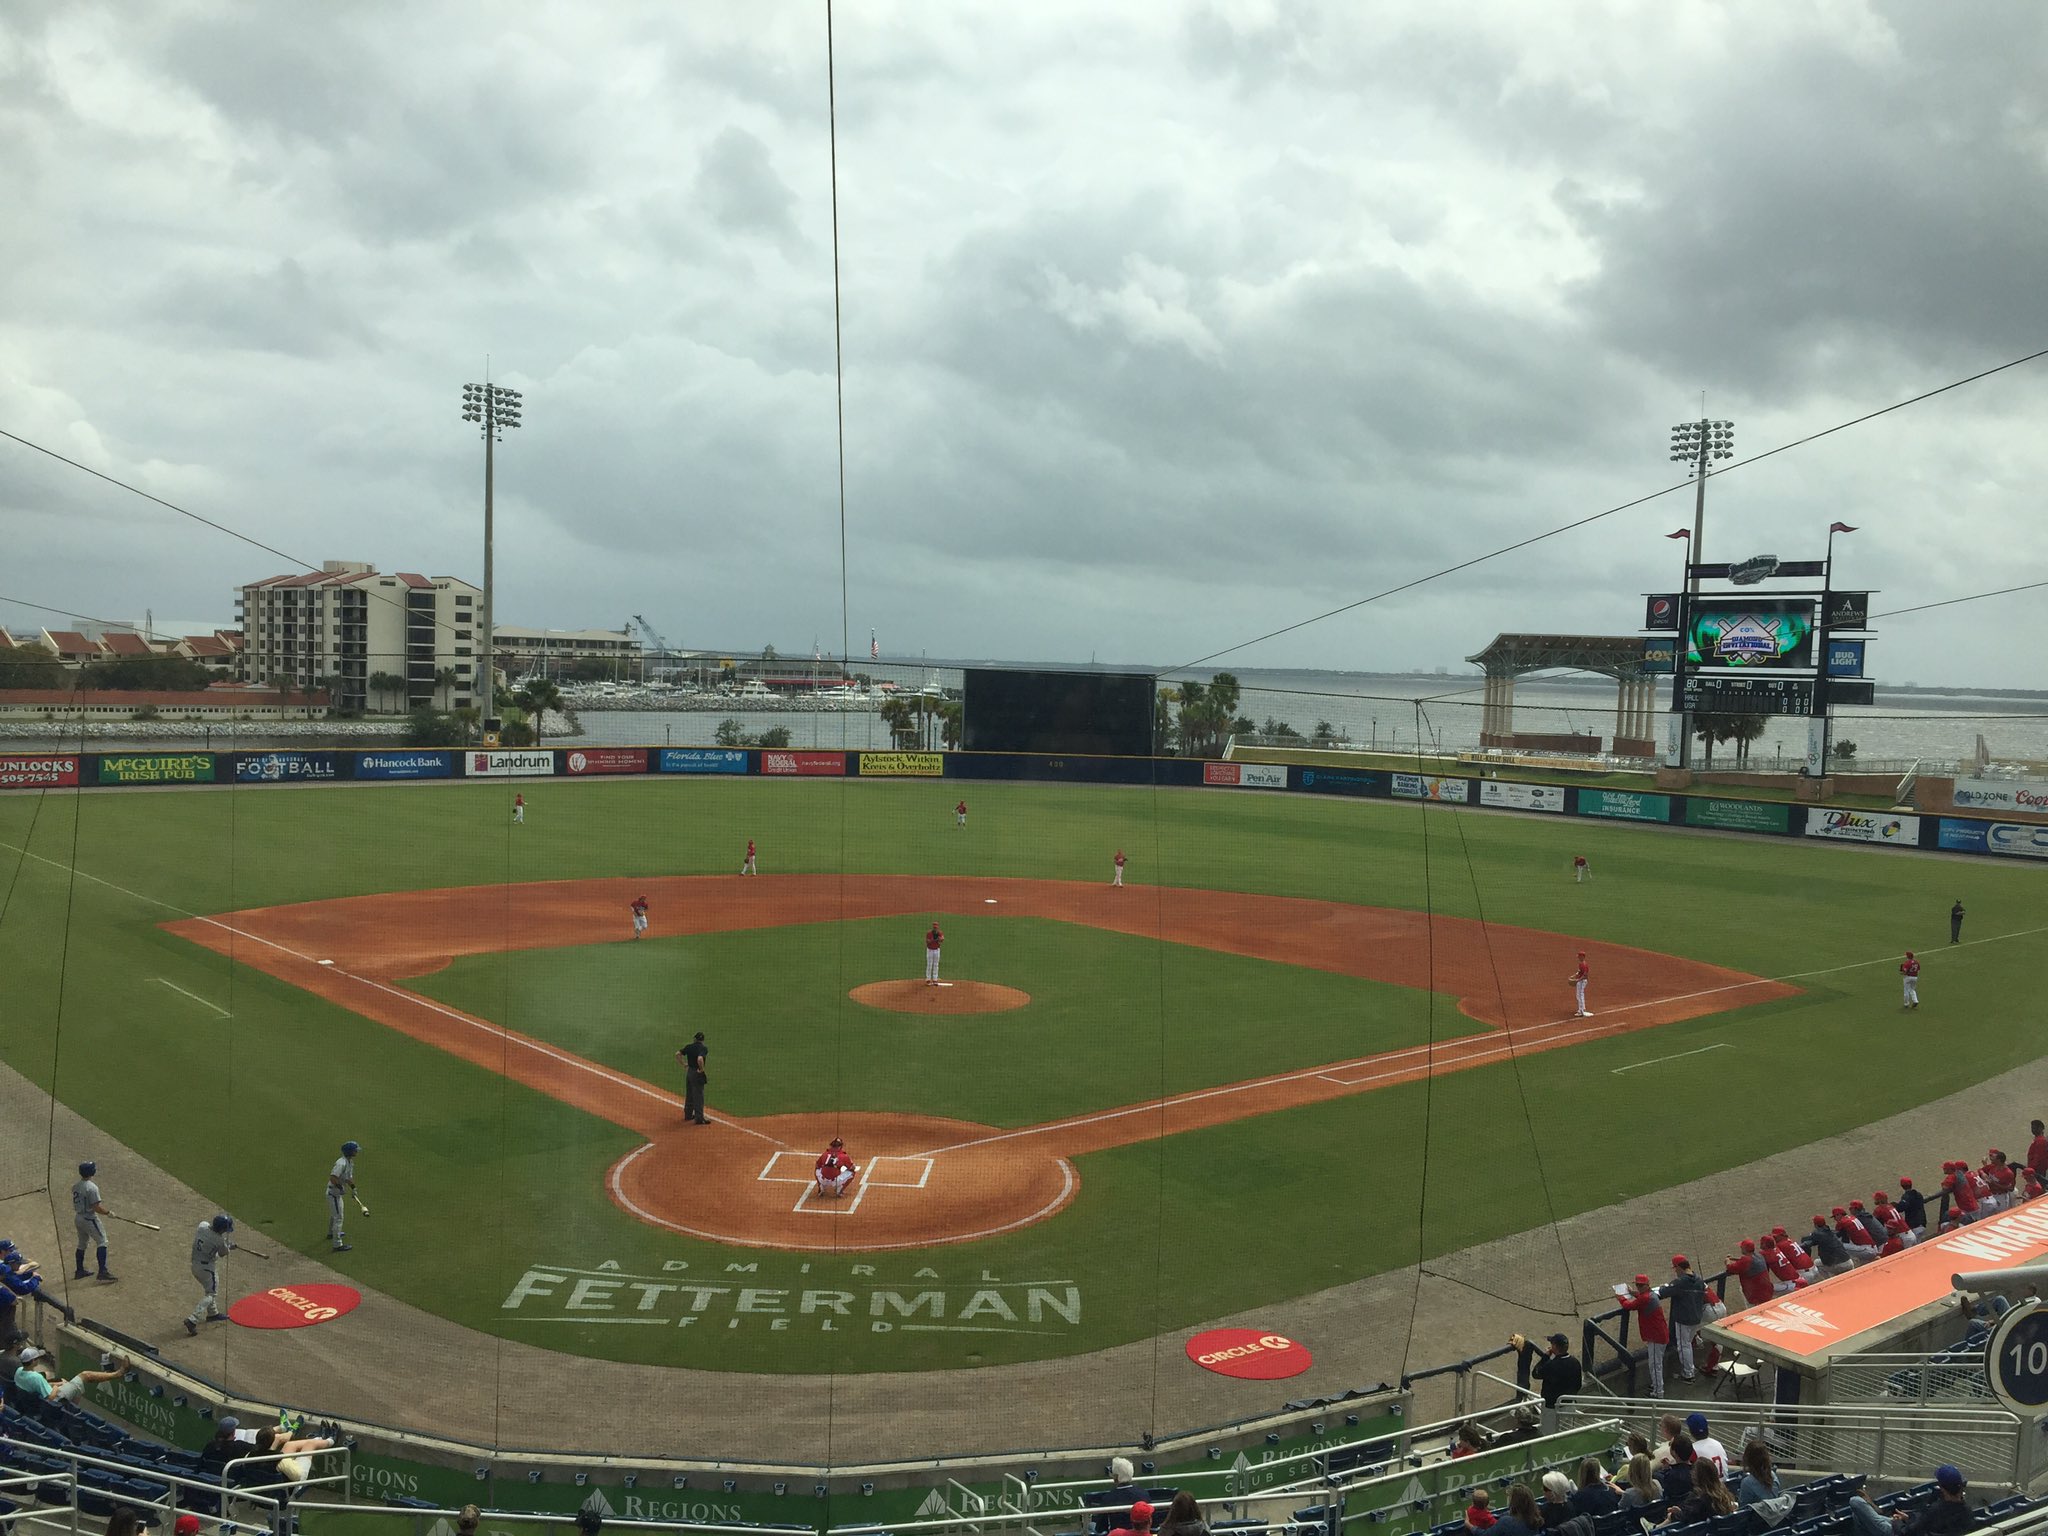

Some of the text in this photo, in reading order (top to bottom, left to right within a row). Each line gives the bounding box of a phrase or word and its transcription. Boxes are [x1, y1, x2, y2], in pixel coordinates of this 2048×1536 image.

[1645, 650, 1672, 661] COX
[1834, 651, 1855, 659] BUD
[1830, 658, 1858, 666] LIGHT
[1686, 679, 1698, 689] 80
[1715, 679, 1722, 689] 0
[1746, 680, 1753, 690] 0
[1777, 681, 1784, 691] 0
[490, 755, 550, 768] Landrum
[666, 752, 723, 760] Florida Blue
[374, 757, 442, 768] Hancock Bank
[897, 762, 941, 771] Overholtz
[236, 762, 335, 775] FOOTBALL
[120, 770, 195, 781] IRISH PUB
[1247, 773, 1282, 783] Pen Air
[1957, 790, 2009, 801] COLD ZONE
[1602, 805, 1641, 814] INSURANCE
[1719, 802, 1764, 812] WOODLANDS
[1823, 811, 1878, 828] Dlux
[595, 1259, 1001, 1282] ADMIRAL
[268, 1287, 318, 1311] CIRCLE
[501, 1271, 1081, 1325] FETTERMAN
[677, 1316, 895, 1333] FIELD
[1198, 1335, 1291, 1364] CIRCLE K
[2009, 1341, 2048, 1376] 10
[118, 1382, 175, 1428] REGIONS
[95, 1393, 175, 1441] CLUB SEATS
[1224, 1472, 1274, 1493] CLUB
[624, 1495, 742, 1522] REGIONS
